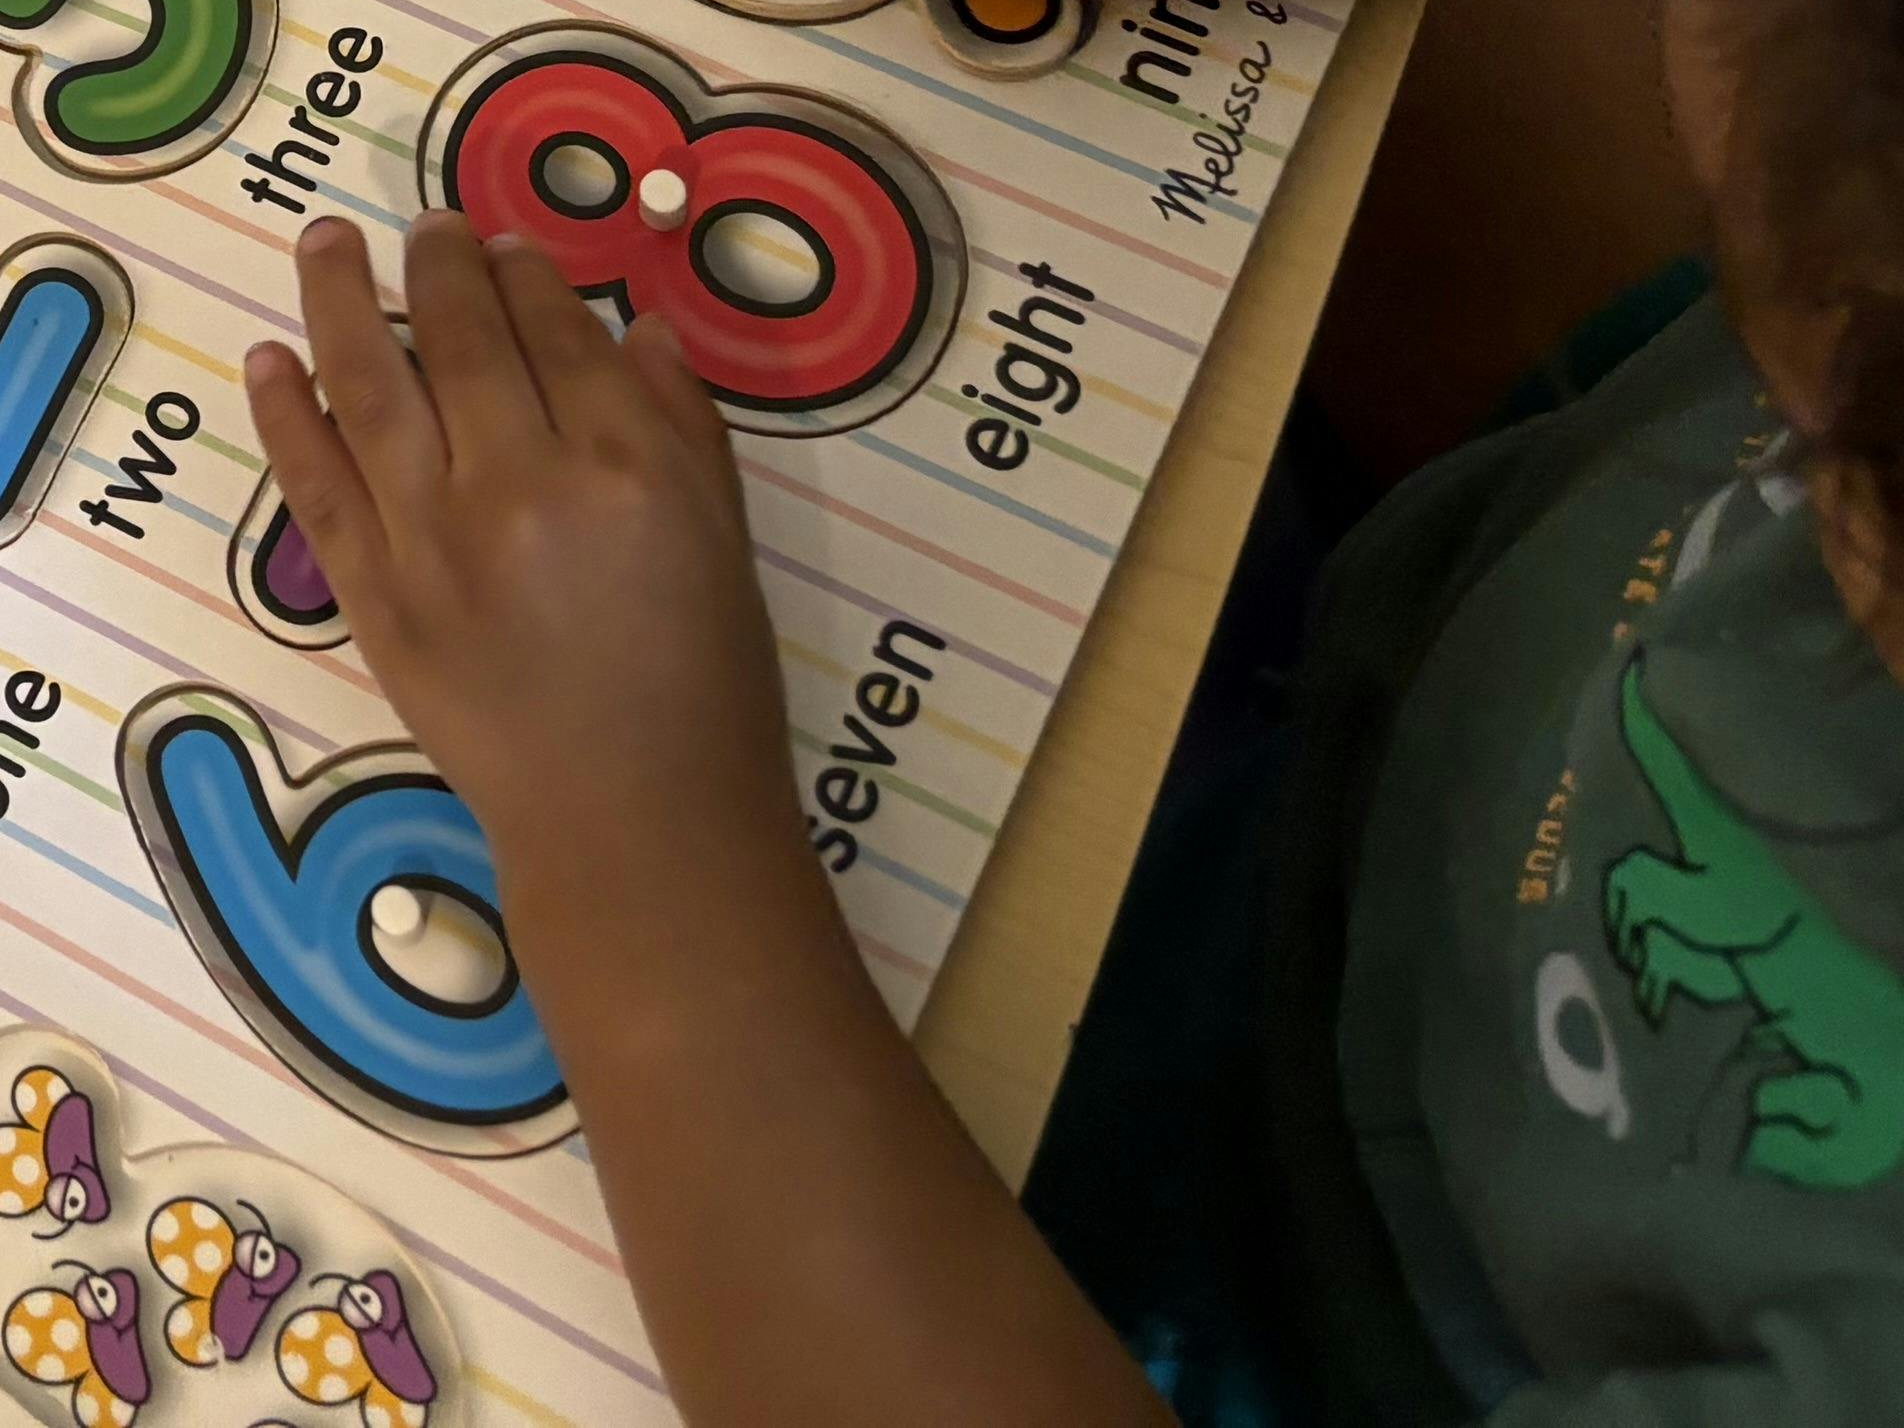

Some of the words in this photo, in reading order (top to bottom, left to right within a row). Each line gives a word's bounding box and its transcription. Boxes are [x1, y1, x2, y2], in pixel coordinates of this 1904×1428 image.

[245, 23, 385, 213] three
[1151, 40, 1272, 224] Melissa
[1247, 0, 1288, 25] &
[444, 47, 934, 416] 8
[81, 388, 198, 539] two
[964, 261, 1094, 470] eight
[147, 711, 565, 1125] 6
